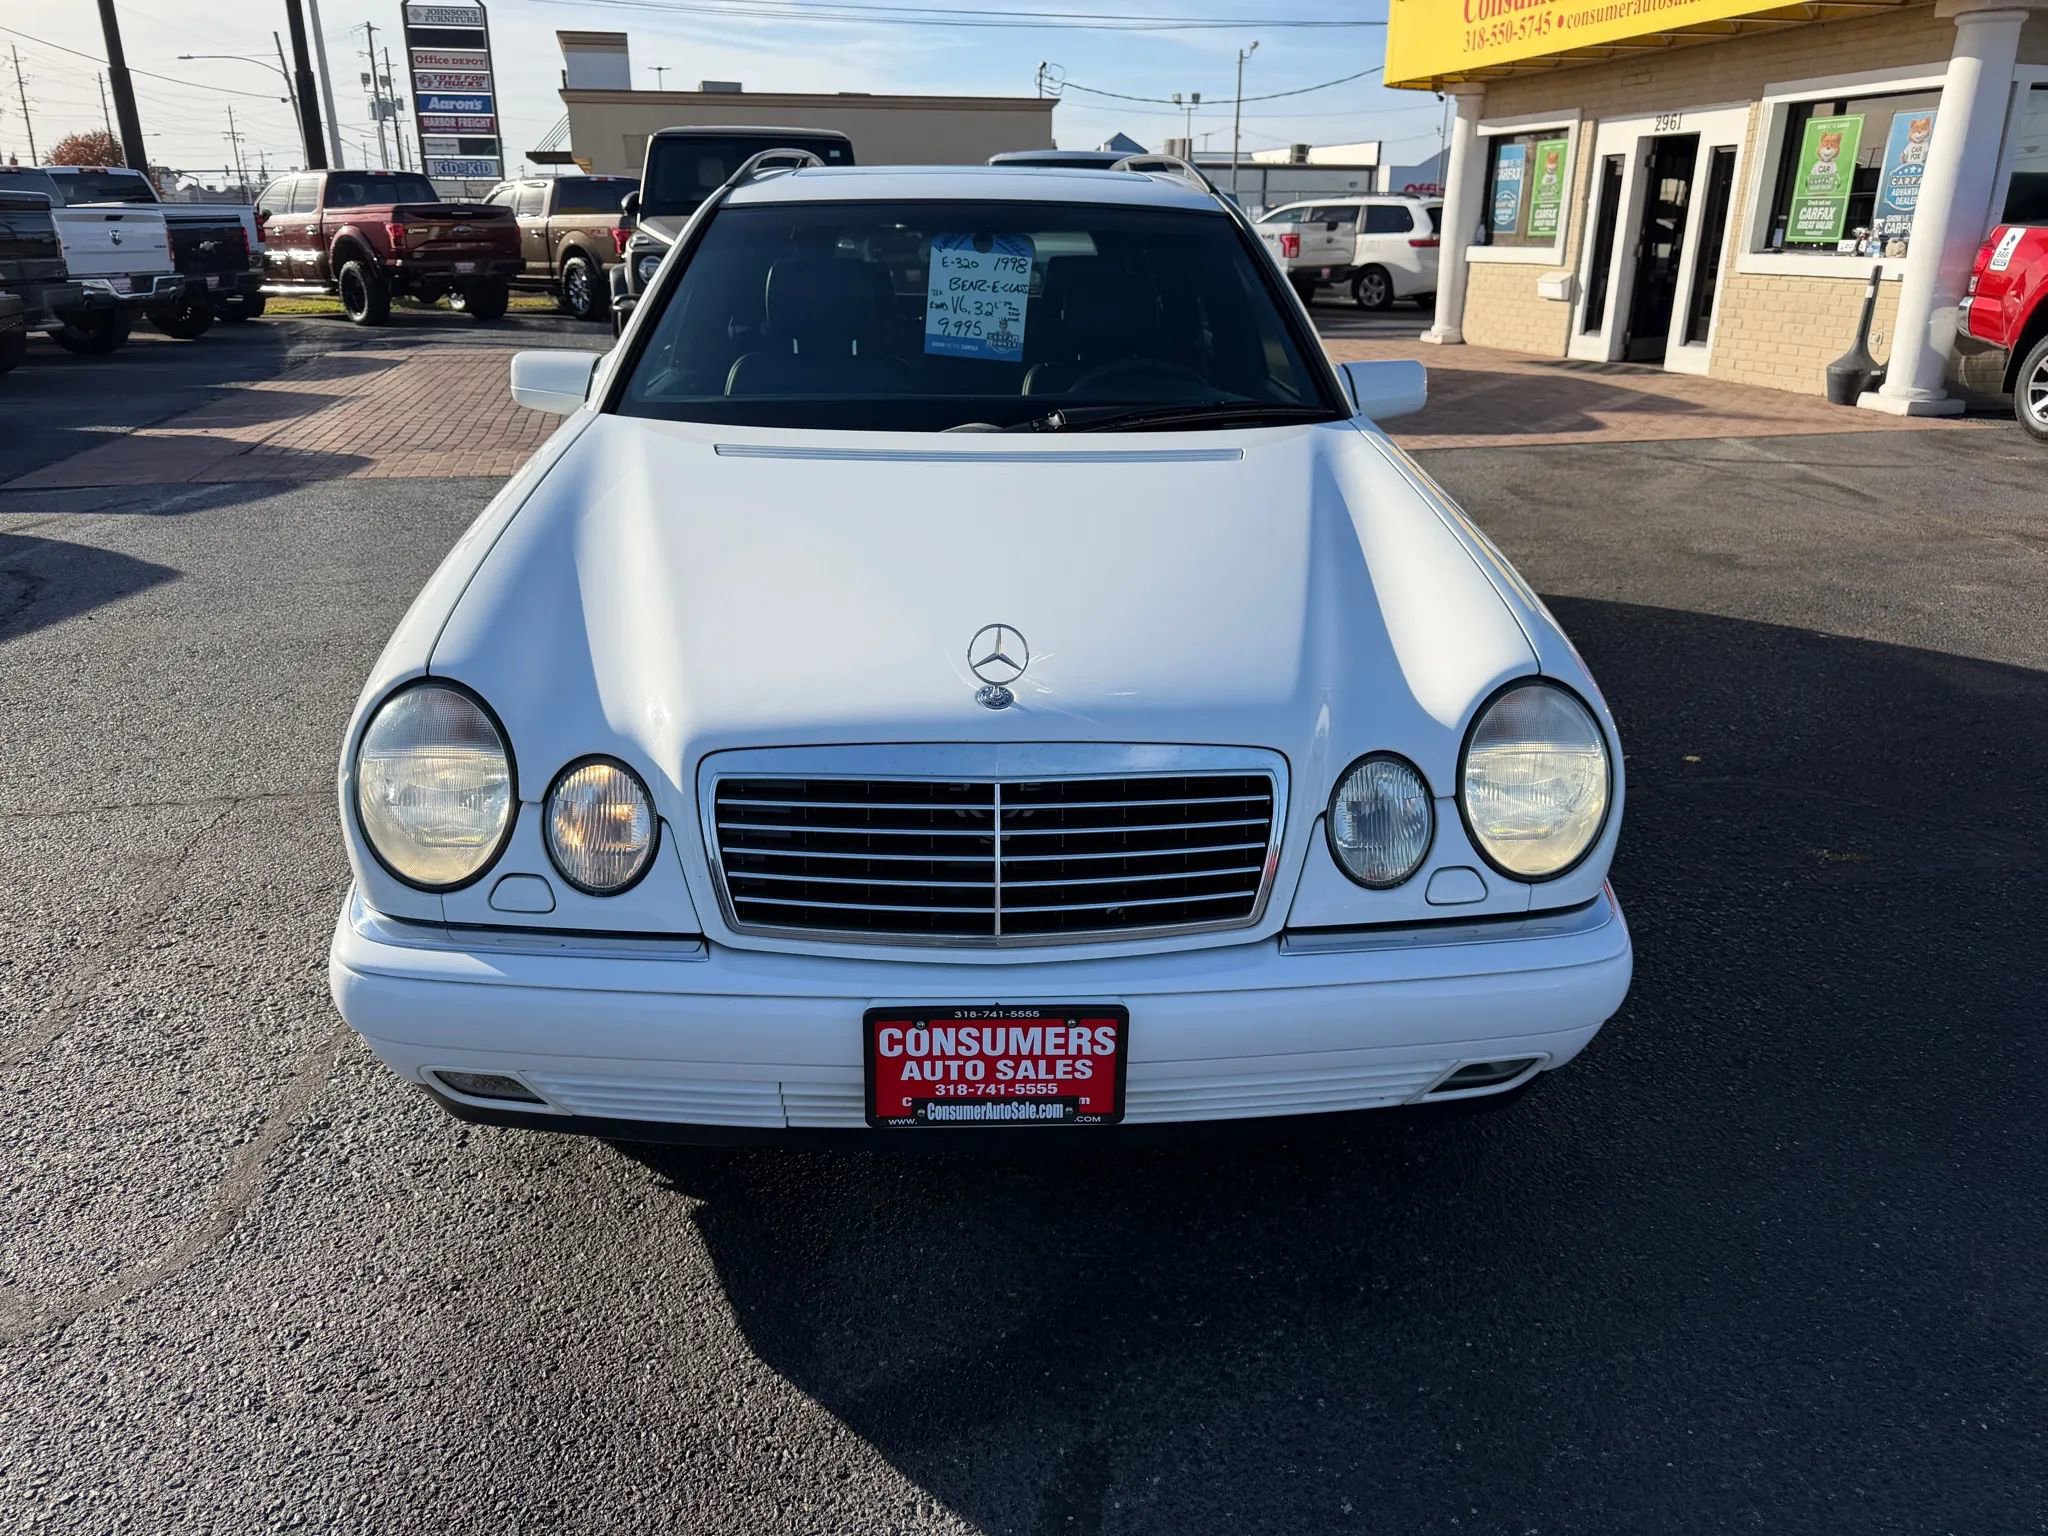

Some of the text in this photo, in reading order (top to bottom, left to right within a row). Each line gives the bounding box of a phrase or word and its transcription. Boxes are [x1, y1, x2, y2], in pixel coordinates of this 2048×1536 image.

[426, 8, 478, 17] JOHNSON'S
[424, 15, 480, 24] FURNITURE
[1463, 10, 1552, 52] 318-550-5745
[416, 55, 484, 66] Office DEPOT
[428, 97, 482, 110] Aaron's
[423, 117, 492, 128] HARBOR FREIGHT
[1654, 114, 1682, 132] 2961
[1799, 207, 1836, 220] CARFAX
[942, 256, 1028, 274] E-320 1998
[938, 317, 982, 338] 9,995
[954, 1010, 1040, 1018] 318-741-5555
[879, 1026, 1116, 1057] CONSUMERS
[900, 1059, 1093, 1081] AUTO SALES
[935, 1084, 1058, 1096] 318-741-5555
[927, 1102, 1064, 1121] ConsumerAutoSale.com
